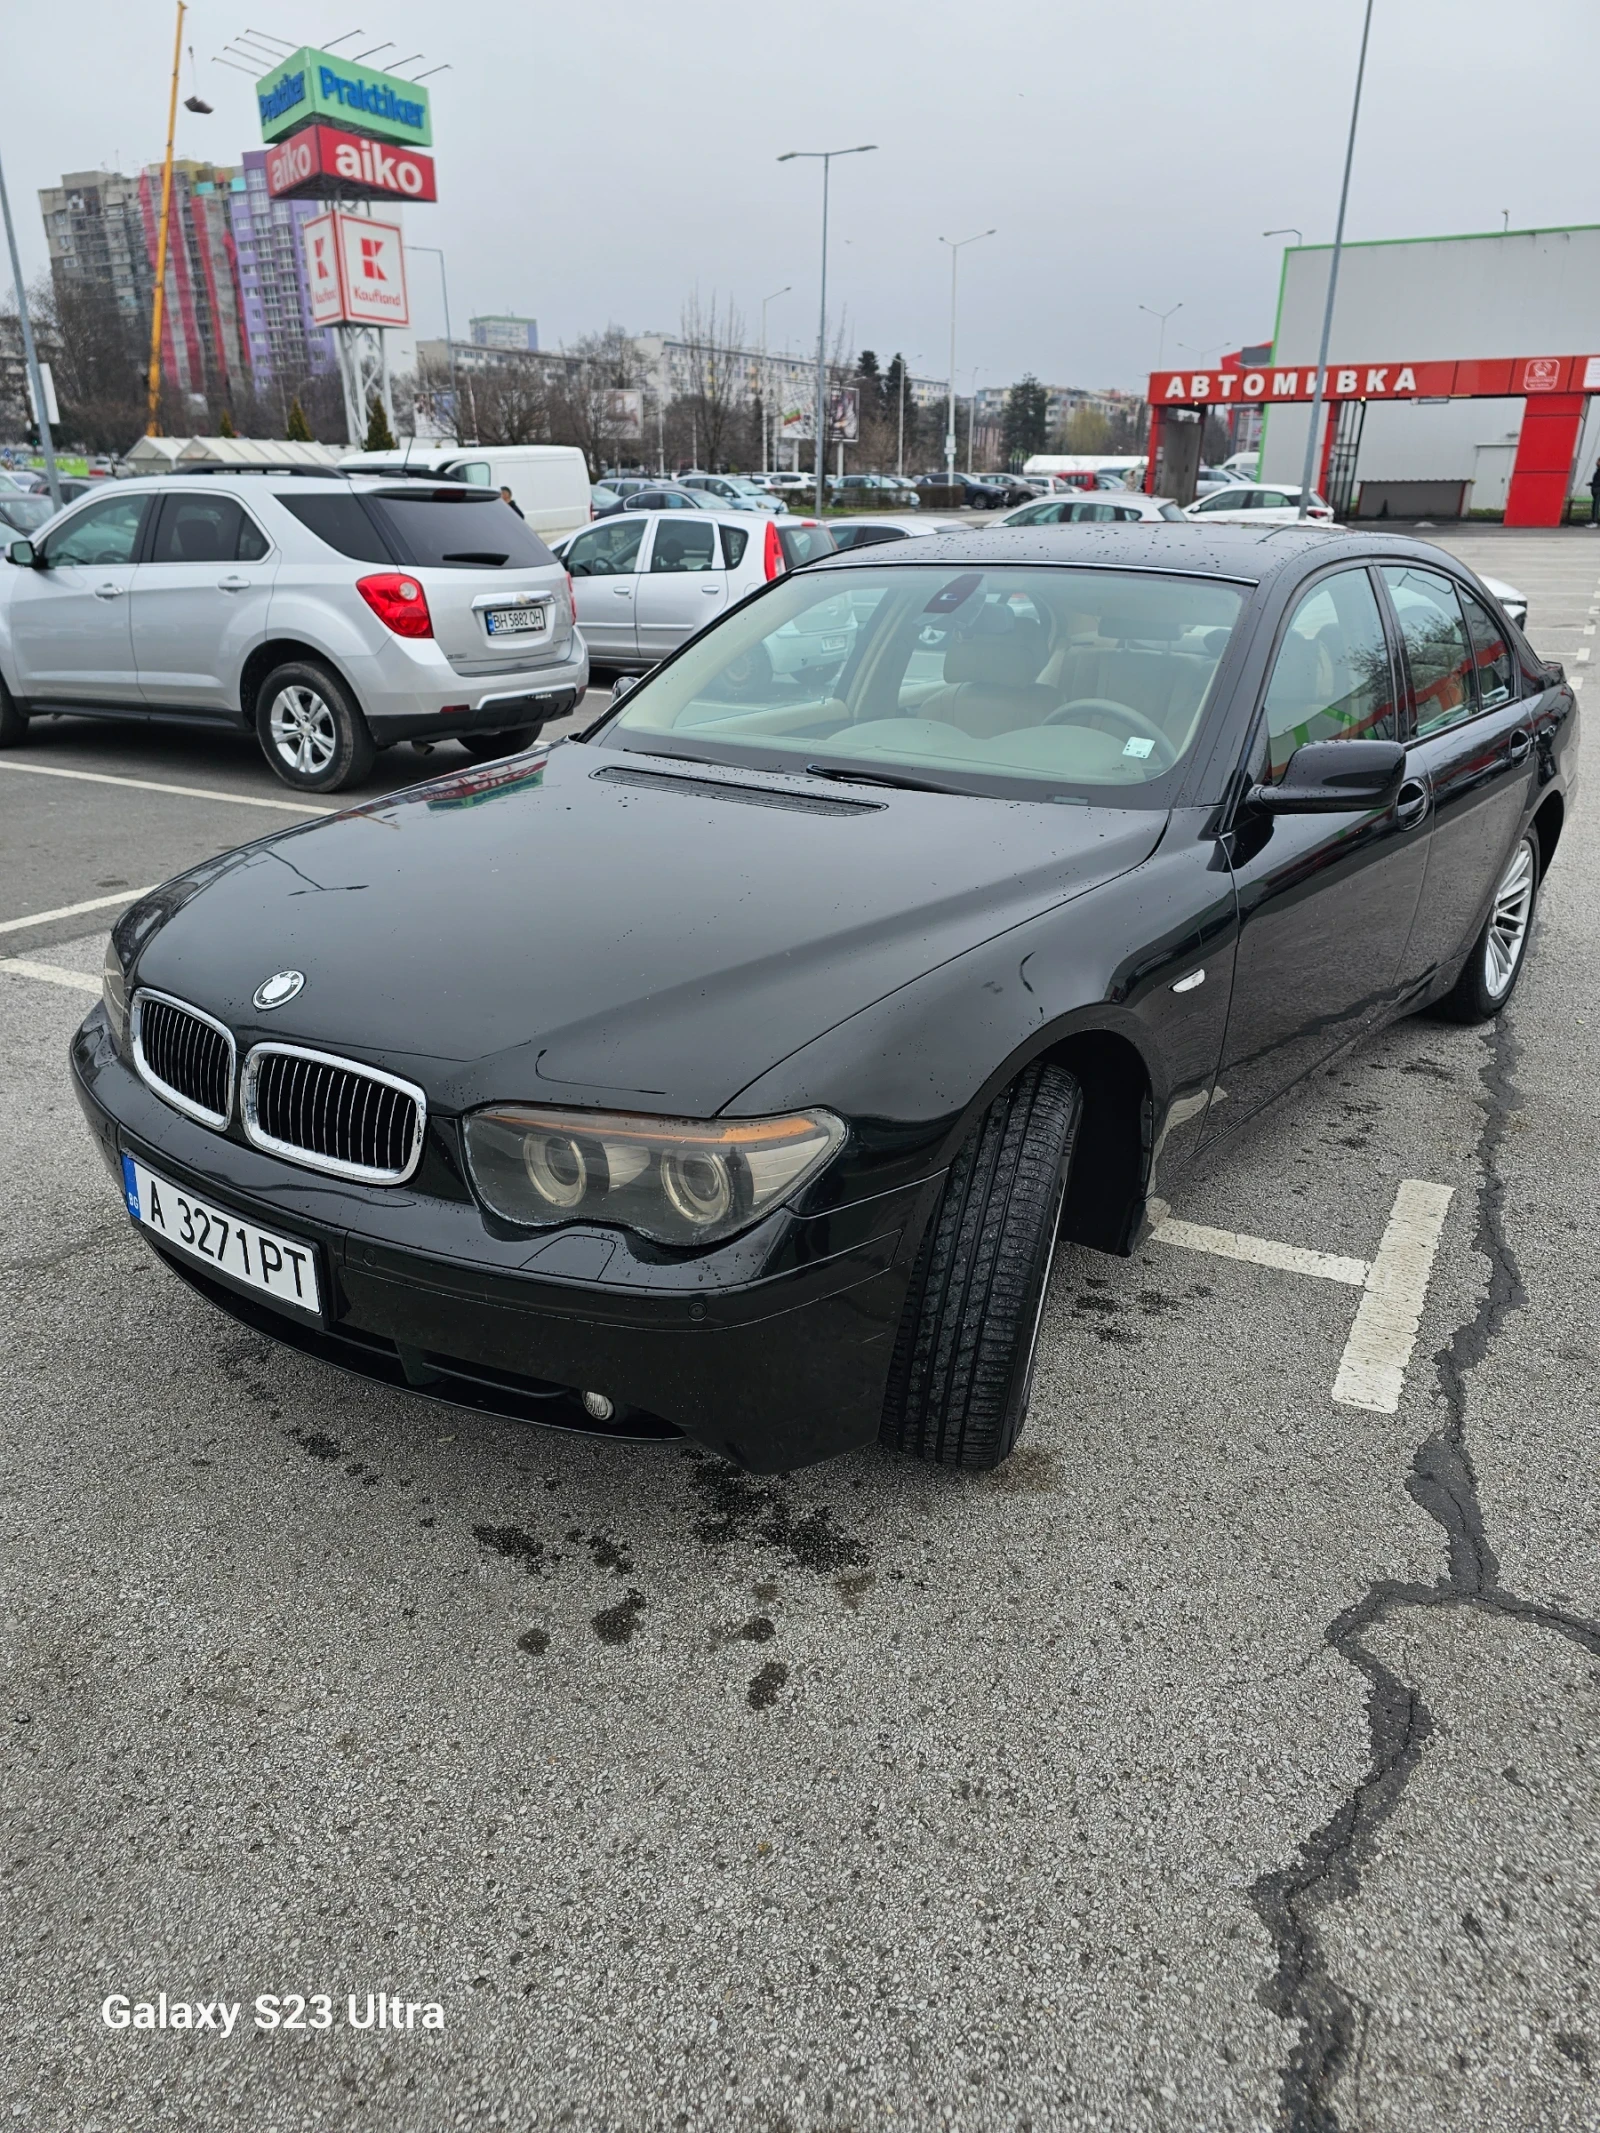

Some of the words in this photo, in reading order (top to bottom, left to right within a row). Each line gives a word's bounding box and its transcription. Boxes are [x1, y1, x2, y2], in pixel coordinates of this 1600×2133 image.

[319, 65, 425, 129] Praktiker
[271, 143, 312, 191] aiko
[335, 139, 424, 194] aiko
[360, 237, 388, 281] K
[354, 286, 401, 307] Kaufland
[1165, 367, 1417, 398] АВТОМИВКА
[493, 614, 509, 629] BH
[508, 611, 529, 627] 5882
[529, 610, 542, 625] OH
[128, 1192, 139, 1210] BG
[151, 1180, 166, 1229] A
[178, 1198, 250, 1275] 3271
[258, 1236, 307, 1298] PT
